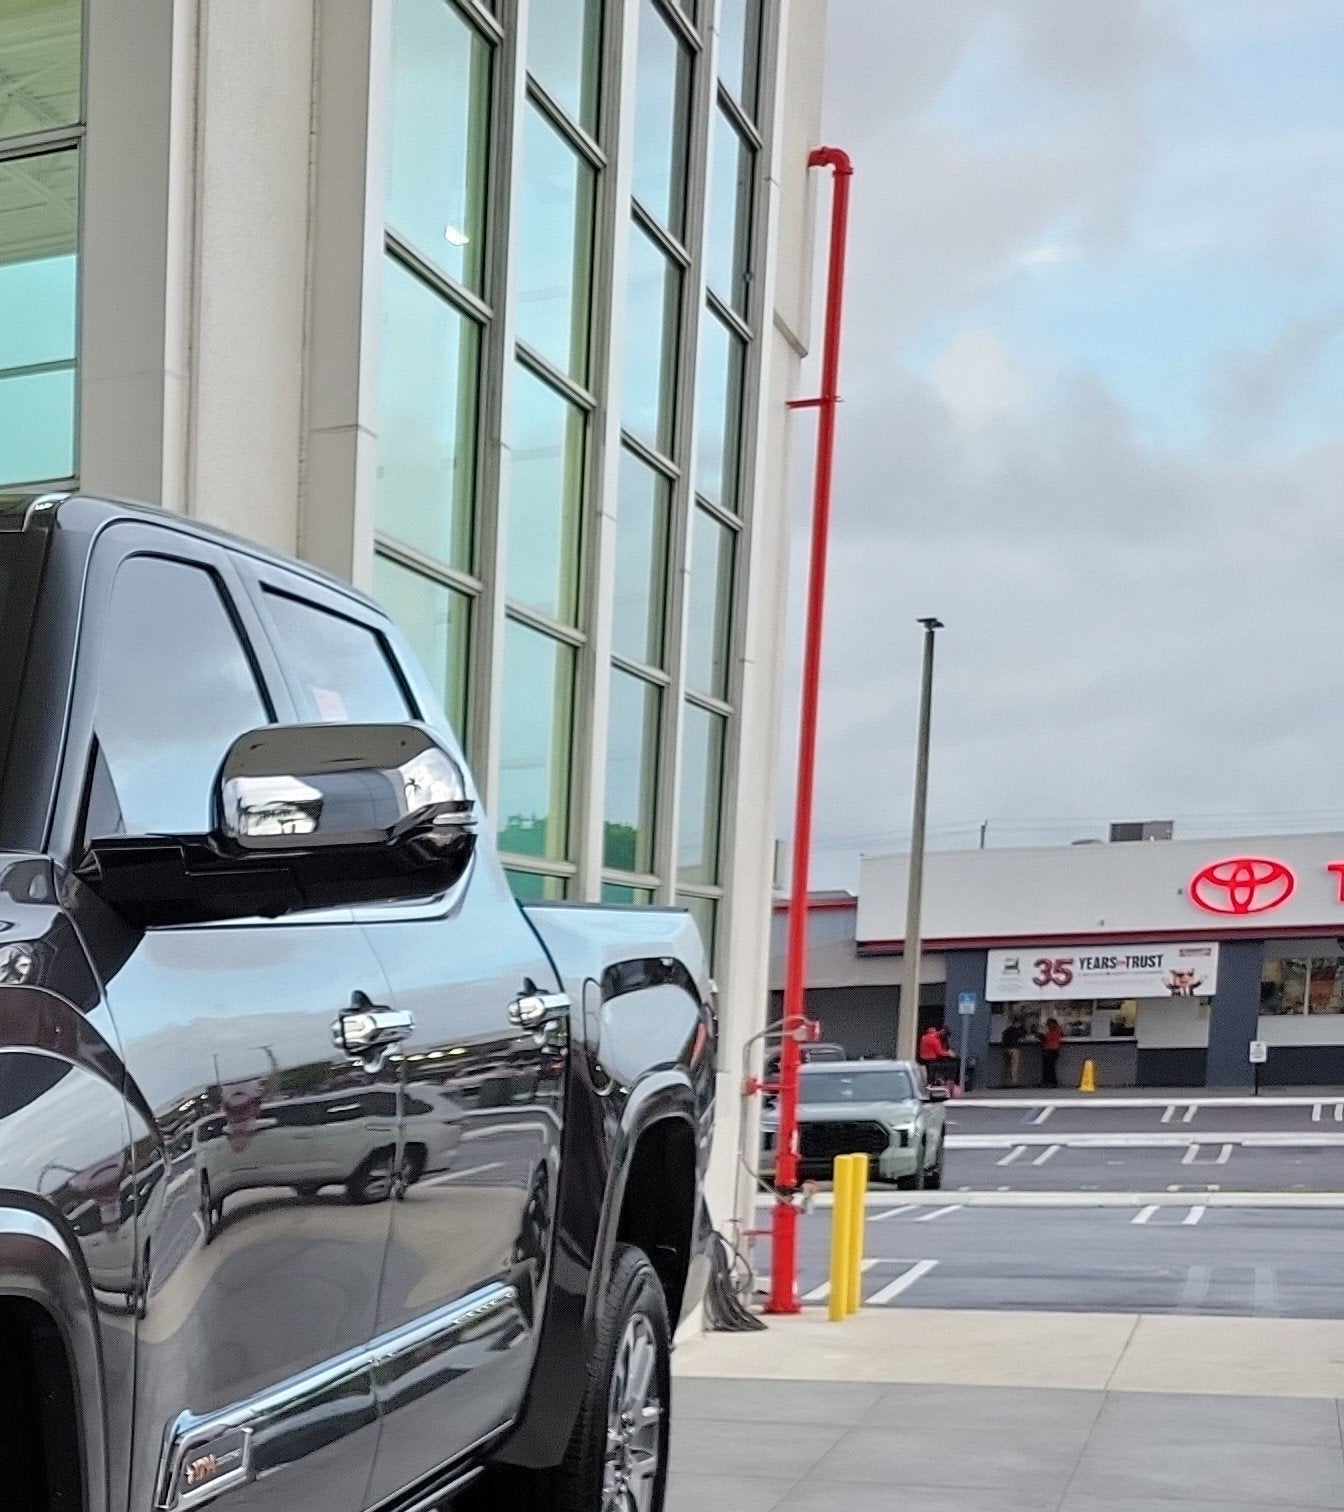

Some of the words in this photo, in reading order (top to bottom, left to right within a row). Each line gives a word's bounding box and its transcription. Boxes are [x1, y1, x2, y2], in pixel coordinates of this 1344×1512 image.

[1031, 958, 1074, 988] 35
[1078, 955, 1118, 971] YEARS
[1124, 954, 1164, 969] TRUST
